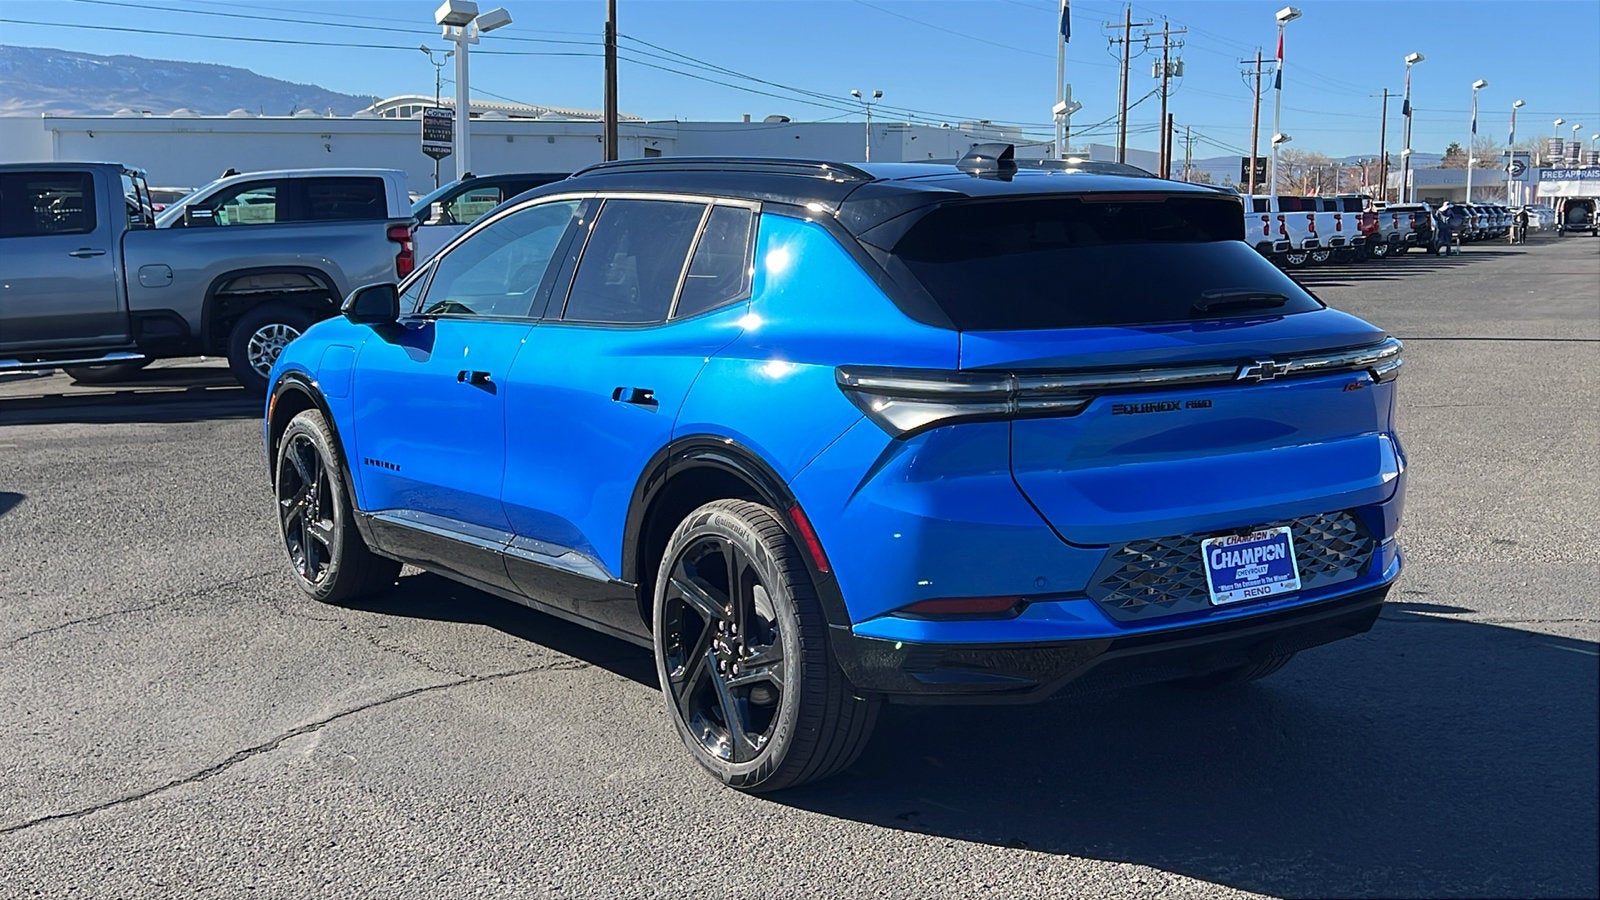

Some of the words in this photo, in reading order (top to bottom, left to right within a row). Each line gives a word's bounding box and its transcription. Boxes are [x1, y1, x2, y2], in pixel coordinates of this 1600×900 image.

[424, 118, 450, 126] GMC
[1542, 171, 1564, 179] FREE
[1112, 400, 1181, 415] EQUINOX
[1226, 531, 1268, 545] CHAMPION
[1211, 542, 1286, 570] CHAMPION
[1237, 566, 1267, 577] CHEVROLET
[1244, 586, 1271, 598] RENO
